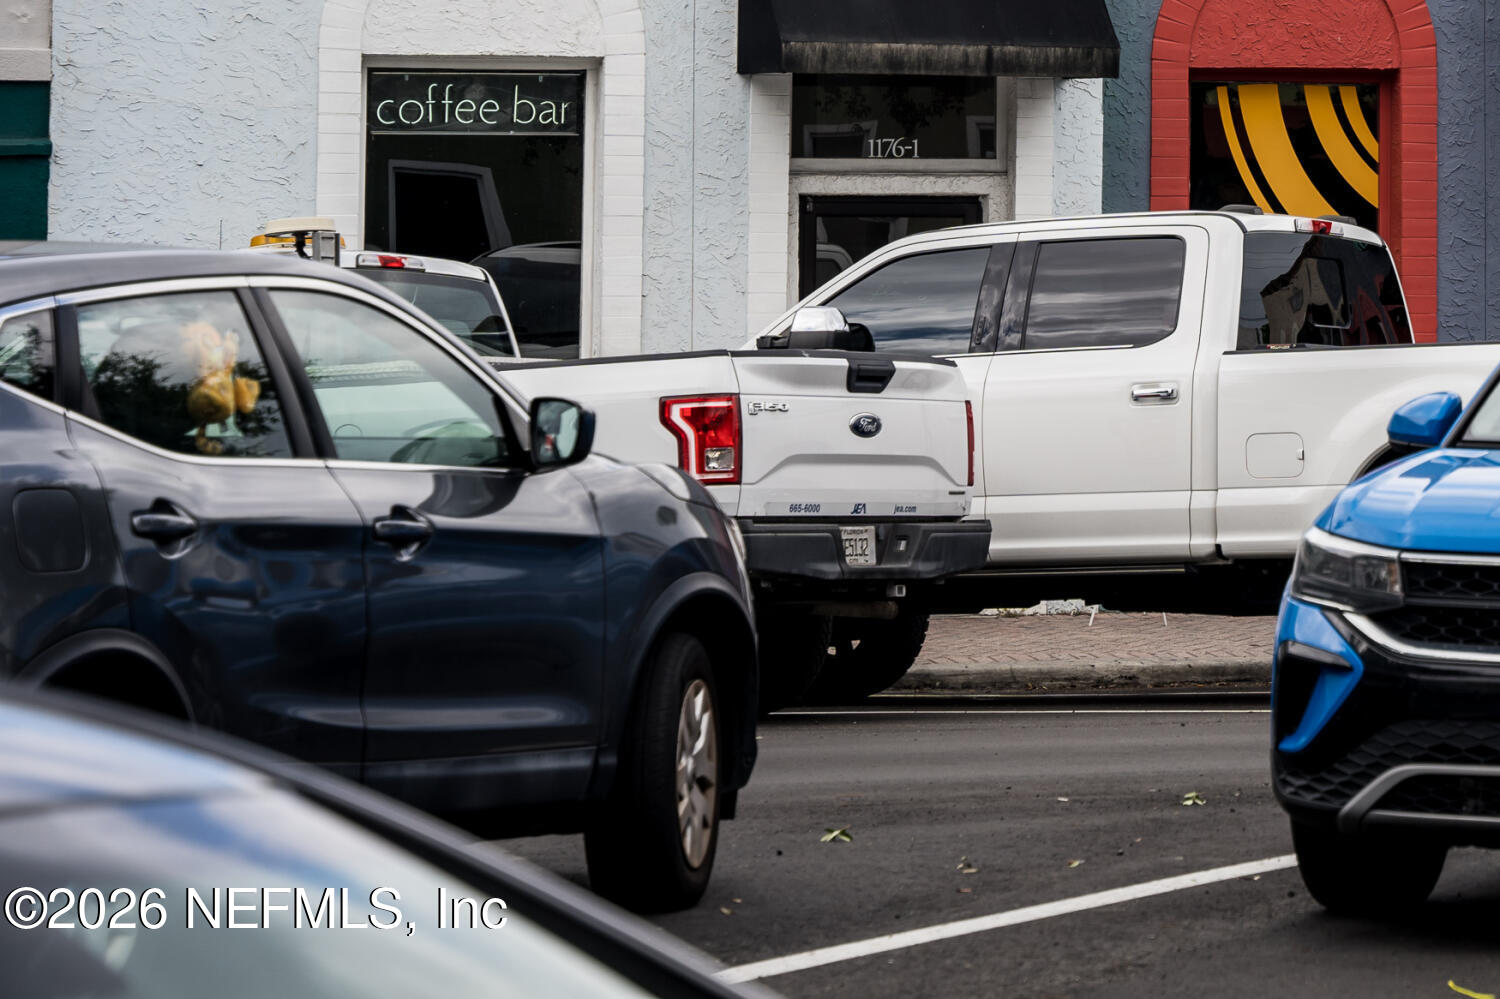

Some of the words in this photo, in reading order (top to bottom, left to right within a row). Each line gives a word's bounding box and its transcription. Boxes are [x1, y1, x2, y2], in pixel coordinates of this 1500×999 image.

[376, 83, 500, 125] coffee
[513, 84, 571, 125] bar
[867, 137, 920, 159] 1176-1
[894, 503, 917, 515] jea.com
